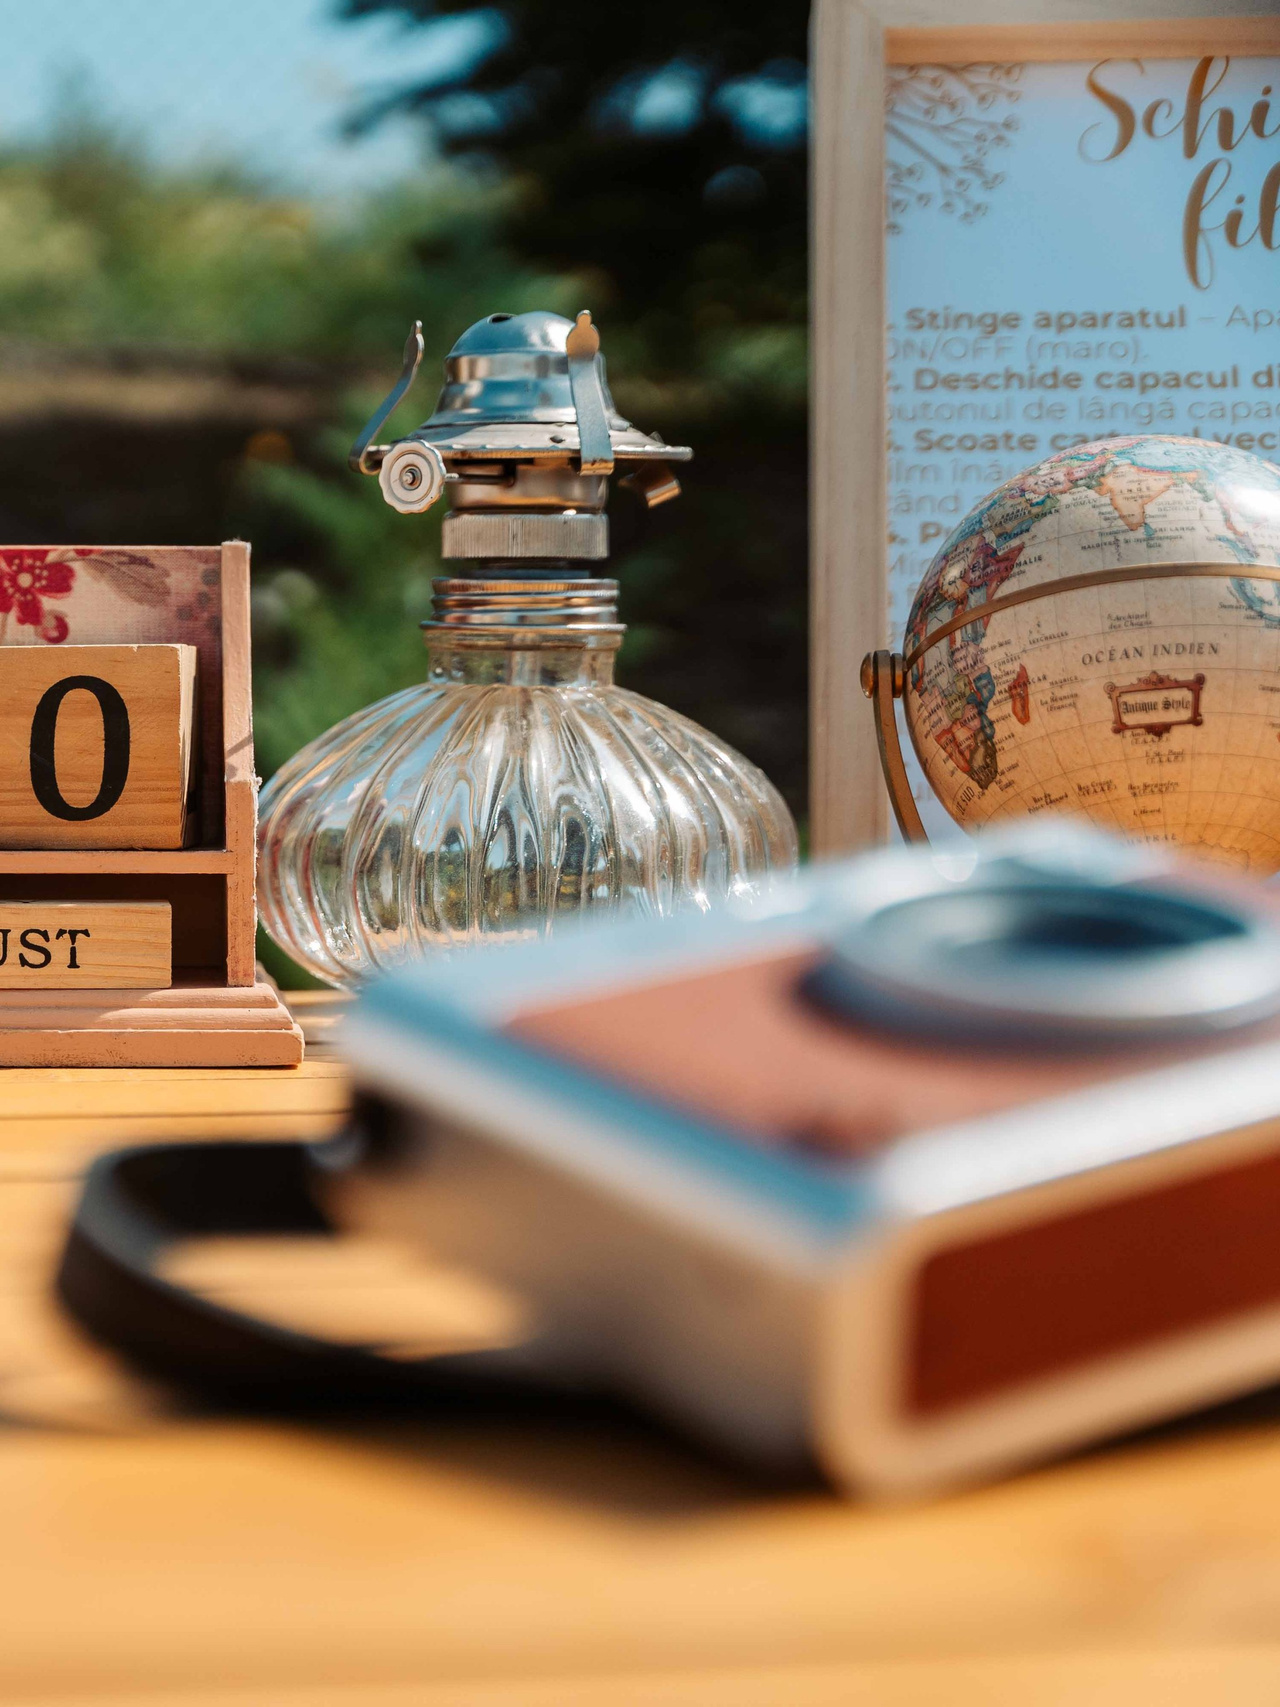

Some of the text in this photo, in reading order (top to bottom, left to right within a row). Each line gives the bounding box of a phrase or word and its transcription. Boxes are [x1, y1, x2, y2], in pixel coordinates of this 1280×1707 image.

[906, 306, 1022, 335] Stinge
[1034, 304, 1187, 335] aparatul
[1225, 304, 1280, 334] Ap
[914, 364, 1083, 391] Deschide
[1095, 364, 1239, 395] capacul
[1022, 397, 1067, 421] de
[1187, 401, 1280, 426] capa
[914, 428, 1037, 452] Scoate
[1081, 643, 1221, 666] OCÉAN INDIEN
[1119, 697, 1191, 714] Antique Style
